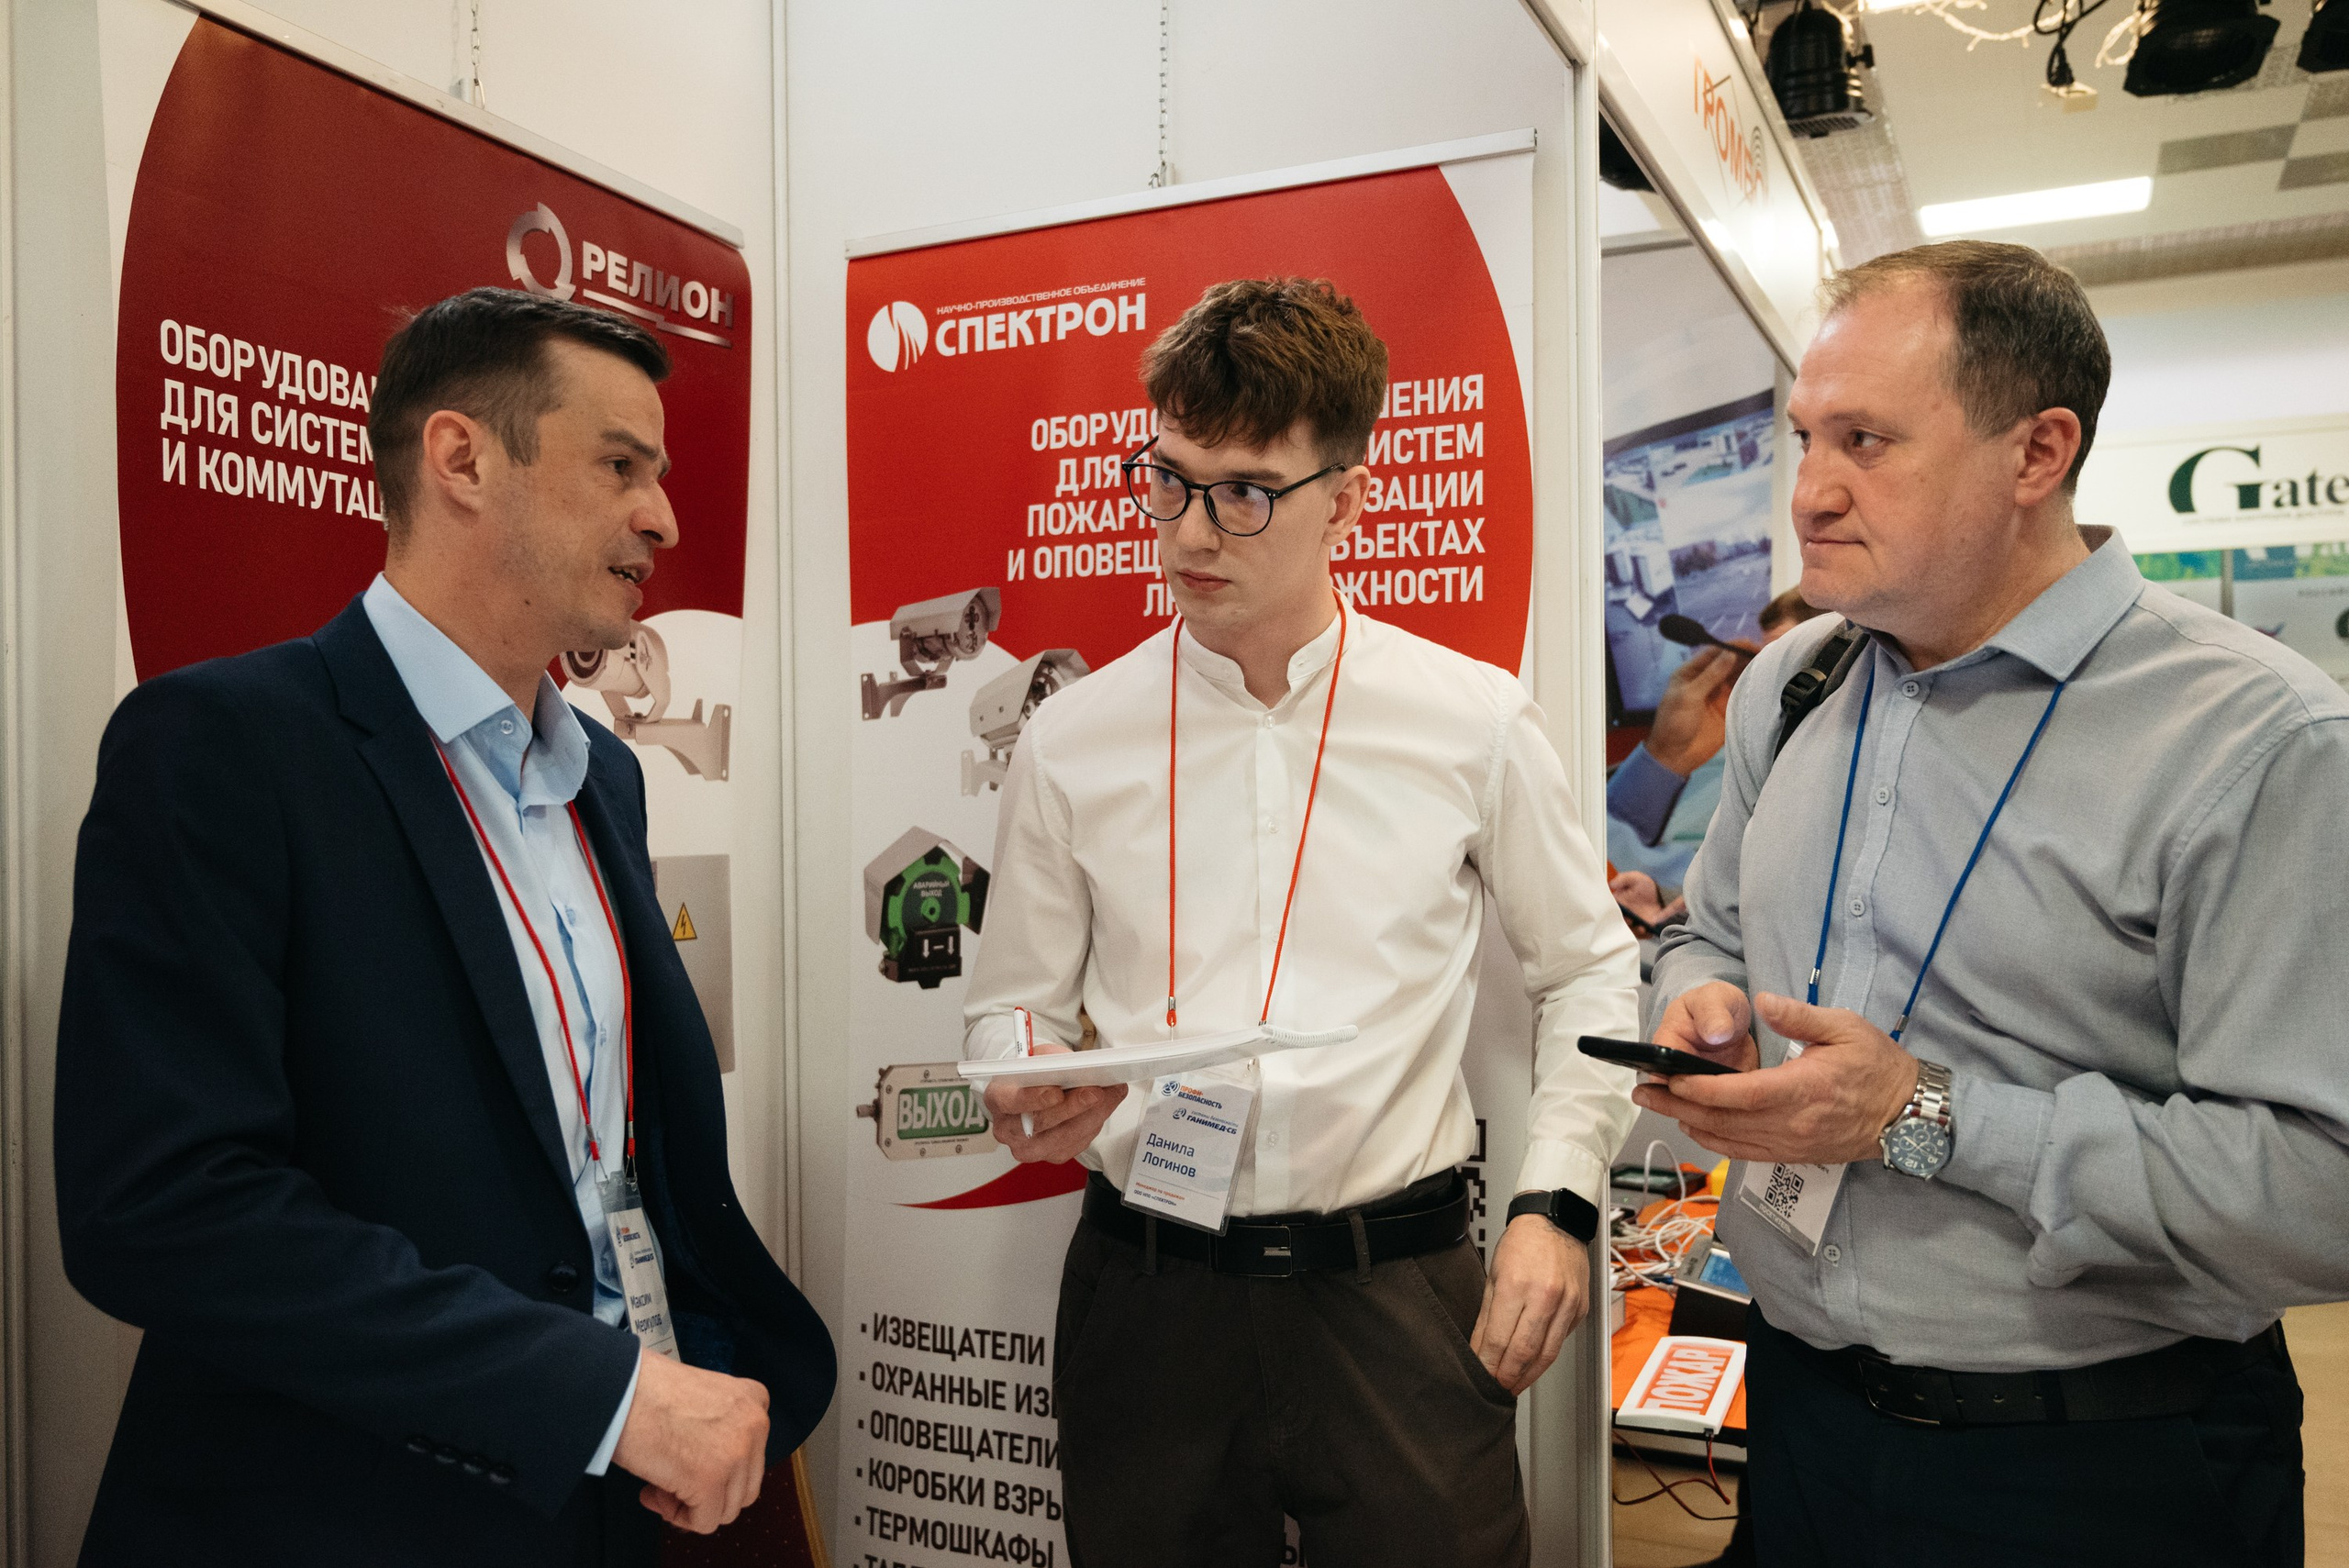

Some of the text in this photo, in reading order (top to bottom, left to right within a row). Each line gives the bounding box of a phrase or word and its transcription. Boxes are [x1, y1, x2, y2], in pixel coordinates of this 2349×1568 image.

[583, 240, 734, 328] РЕЛИОН
[937, 277, 1146, 315] НАУЧНО-ПРОИЗВОДСТВЕННОЕ ОБЪЕДИНЕНИЕ
[935, 293, 1146, 357] СПЕКТРОН
[161, 378, 239, 439] ДЛЯ
[161, 437, 186, 486] И
[1055, 454, 1121, 498] ДЛЯ
[1364, 421, 1484, 466] ИСТЕМ
[1008, 548, 1026, 583] И
[1033, 539, 1163, 580] ОПОВЕЩ
[1330, 565, 1484, 606] ЖНОСТИ
[898, 1090, 985, 1130] ВЫХОД
[1177, 1091, 1222, 1109] БЕЗОПАСНОСТЬ
[1142, 1151, 1197, 1178] Логинов
[1146, 1133, 1195, 1157] Данила
[874, 1312, 1045, 1366] ИЗВЕЩАТЕЛИ
[872, 1361, 1057, 1419] ОХРАННЫЕ ИЗ
[1642, 1348, 1727, 1415] ПОЖАР
[870, 1409, 1061, 1471] ОПОВЕЩАТЕЛИ
[869, 1457, 985, 1507] КОРОБКИ
[865, 1506, 1054, 1568] ТЕРМОШКАФЫ
